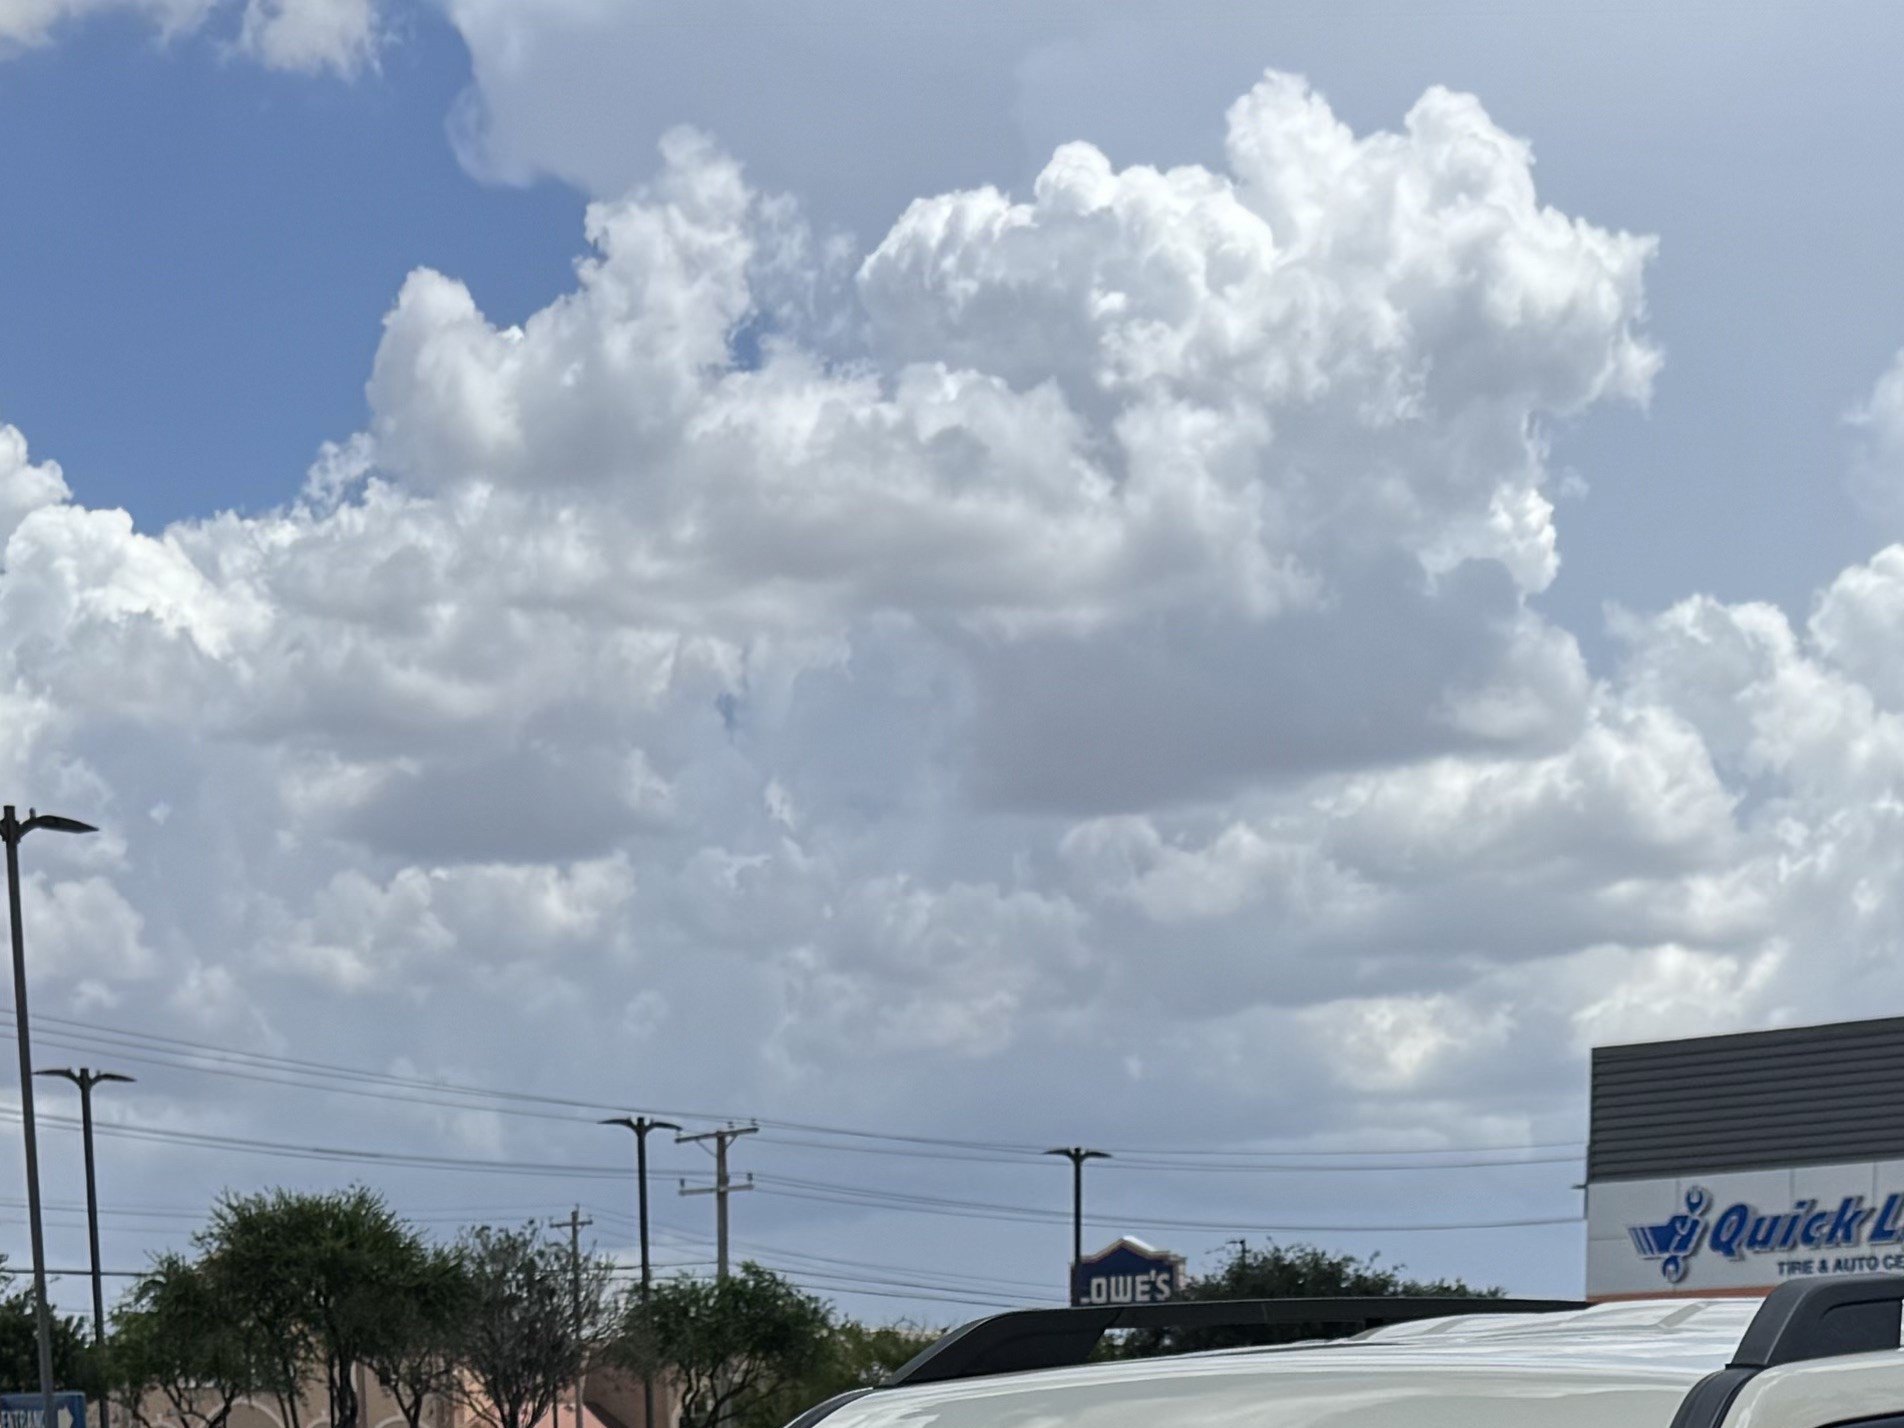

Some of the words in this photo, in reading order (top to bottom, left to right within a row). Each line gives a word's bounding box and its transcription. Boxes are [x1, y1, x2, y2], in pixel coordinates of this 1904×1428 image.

[1708, 1195, 1868, 1258] Quick
[1777, 1260, 1813, 1276] TIRE
[1817, 1259, 1828, 1274] &
[1833, 1256, 1879, 1273] AUTO
[1080, 1269, 1171, 1304] OWE'S
